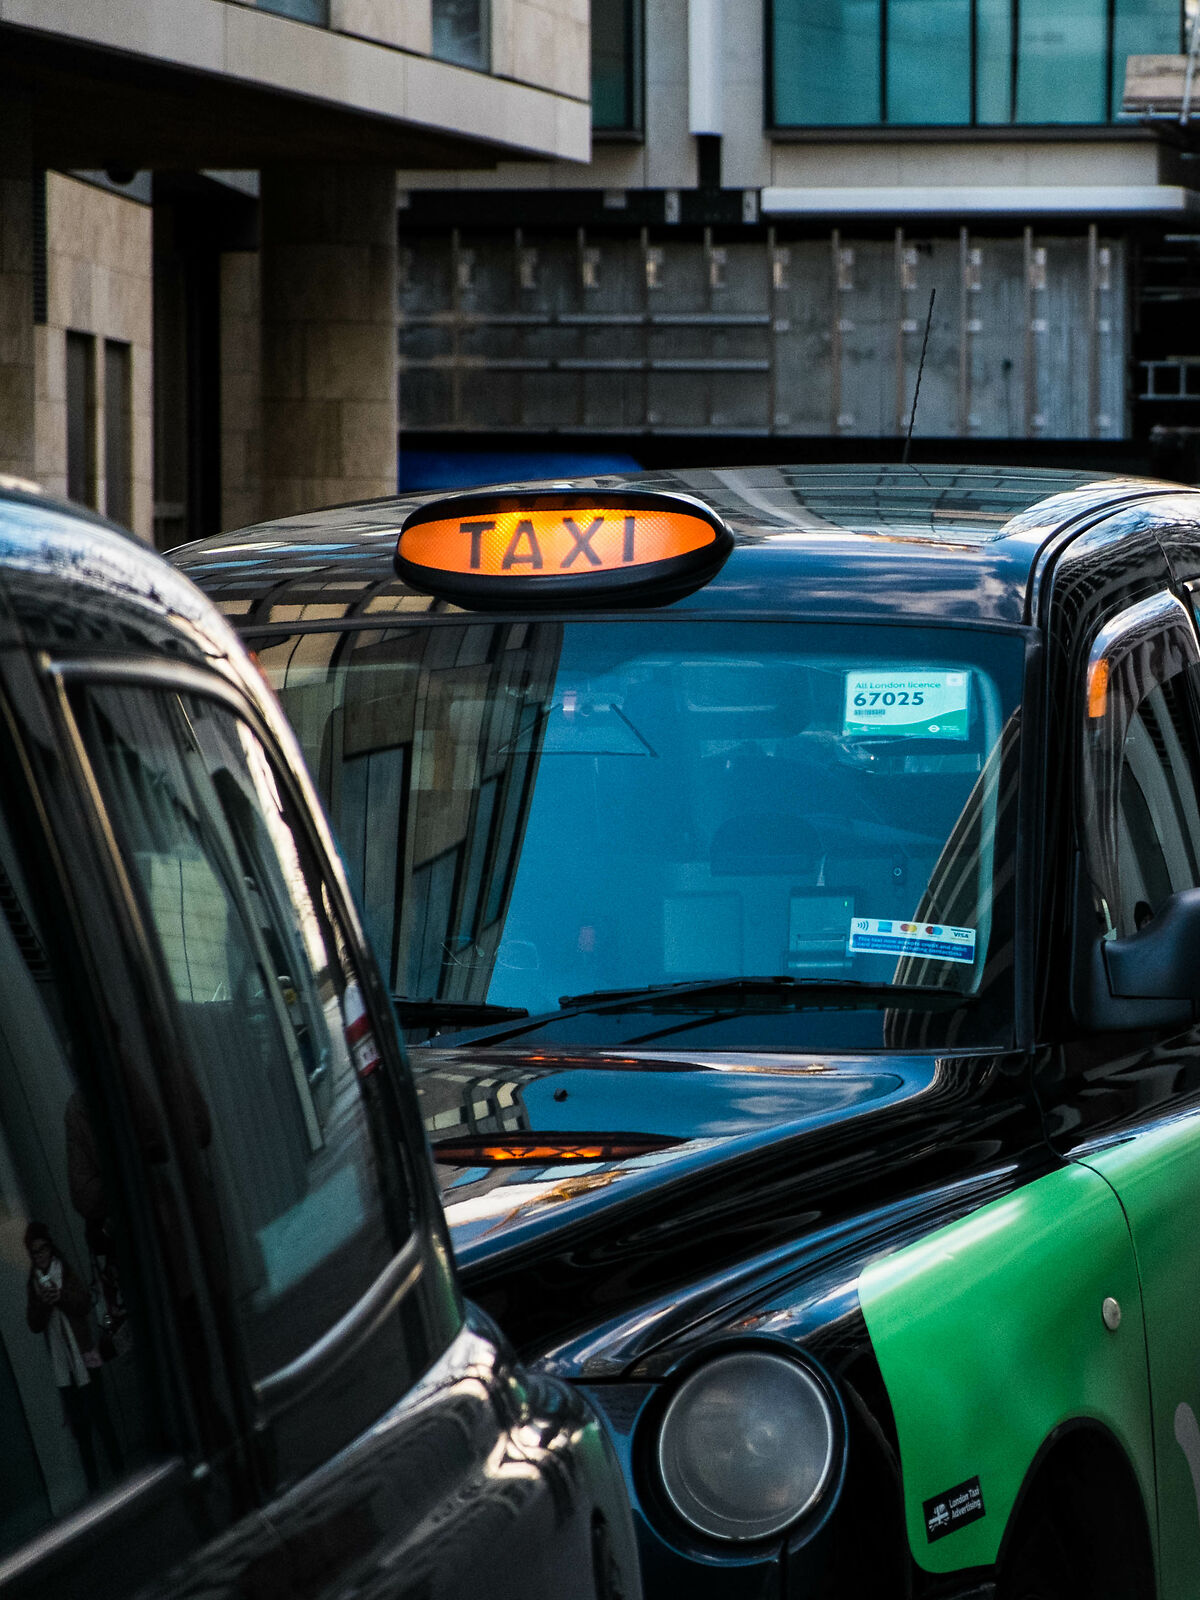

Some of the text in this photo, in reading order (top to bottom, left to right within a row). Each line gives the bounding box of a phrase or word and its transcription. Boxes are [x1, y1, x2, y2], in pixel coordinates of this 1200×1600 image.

[460, 516, 636, 570] TAXI
[870, 681, 906, 689] London
[908, 681, 941, 689] licence
[853, 691, 924, 707] 67025
[948, 1493, 969, 1509] London
[951, 1499, 981, 1519] Advertising
